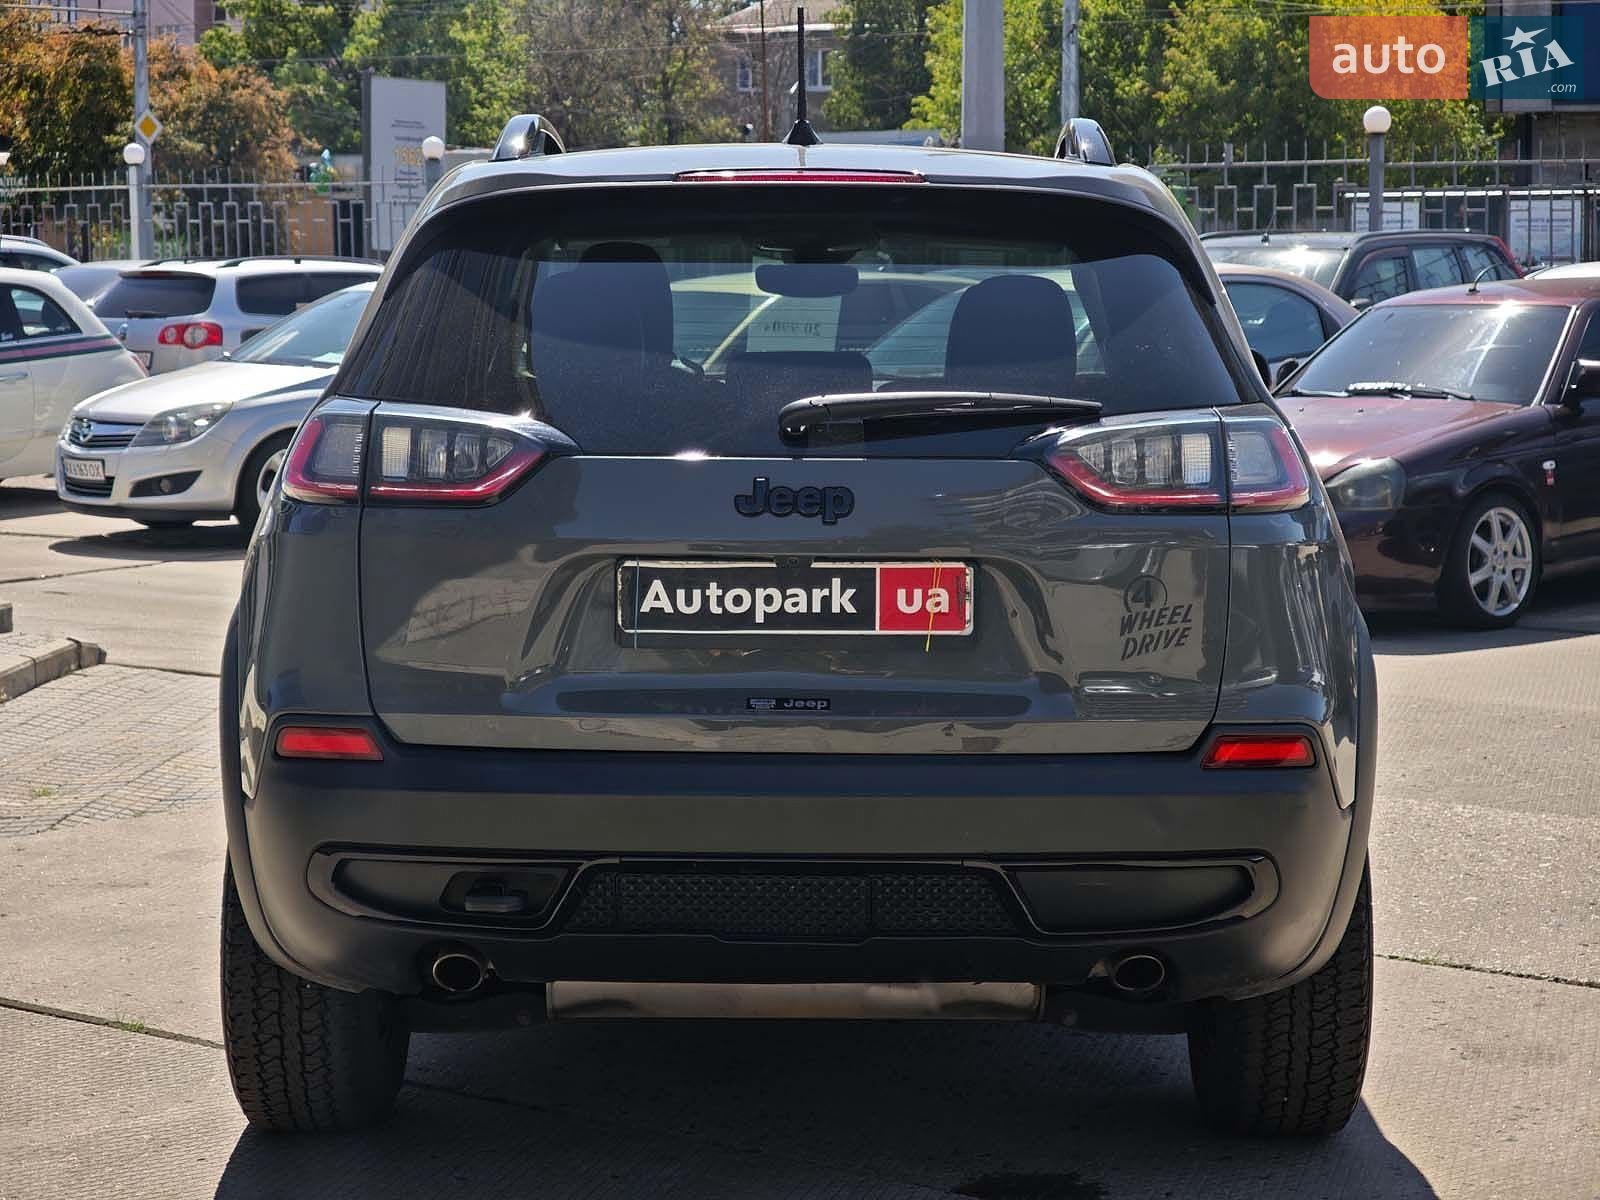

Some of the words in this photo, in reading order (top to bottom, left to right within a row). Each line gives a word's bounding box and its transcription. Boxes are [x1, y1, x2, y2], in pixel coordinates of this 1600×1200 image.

[734, 476, 855, 526] Jeep
[640, 578, 857, 623] Autopark
[896, 587, 949, 614] ua
[1120, 603, 1193, 636] WHEEL
[1121, 627, 1192, 661] DRIVE
[783, 699, 829, 710] Jeep
